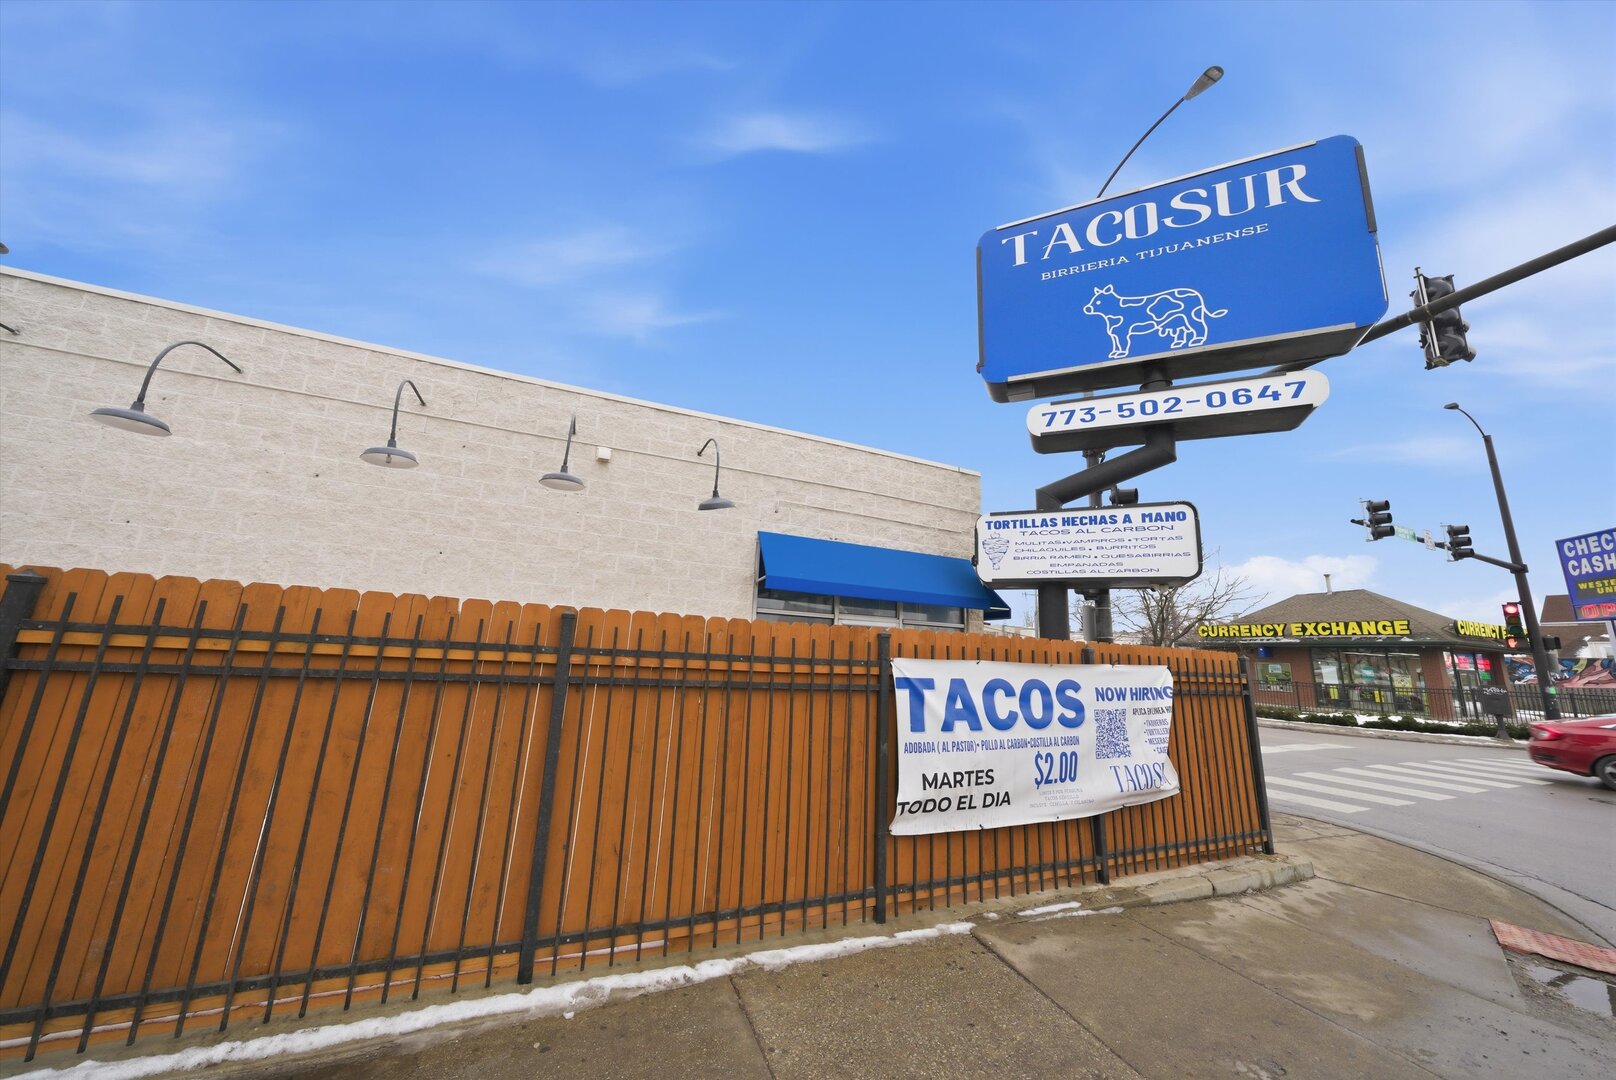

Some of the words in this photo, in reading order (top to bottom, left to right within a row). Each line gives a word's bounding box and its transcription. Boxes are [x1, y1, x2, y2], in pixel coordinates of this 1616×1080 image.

[1001, 163, 1322, 267] TACOSUR
[1040, 255, 1130, 281] BIRRIERIA
[1135, 223, 1269, 260] TIJUANENSE
[1041, 380, 1307, 427] 773-502-0647
[985, 517, 1058, 530] TORTILLAS
[1062, 513, 1118, 527] HECHAS
[1122, 514, 1133, 524] A
[1141, 511, 1187, 523] MANO
[1019, 528, 1071, 537] TACOS
[1100, 525, 1174, 534] CARBON
[1014, 545, 1086, 553] CHILAQUILES
[1101, 551, 1191, 559] QUESABIRRIAS
[1563, 531, 1616, 558] CHEC
[1567, 552, 1616, 576] CASH
[1198, 623, 1285, 638] CURRENCY
[1290, 619, 1411, 637] EXCHANGE
[1457, 620, 1502, 639] CURRENCY
[895, 676, 1086, 733] TACOS
[1095, 687, 1127, 702] NOW
[1129, 685, 1174, 702] HIRING
[904, 741, 936, 754] ADOBADA
[981, 739, 998, 750] POLLO
[999, 739, 1006, 750] AL
[1053, 736, 1060, 747] AL
[1060, 735, 1080, 746] CARBON
[922, 769, 995, 791] MARTES
[1034, 750, 1078, 790] $2.00
[897, 794, 953, 817] TODO
[956, 795, 977, 811] EL
[982, 791, 1011, 808] DIA
